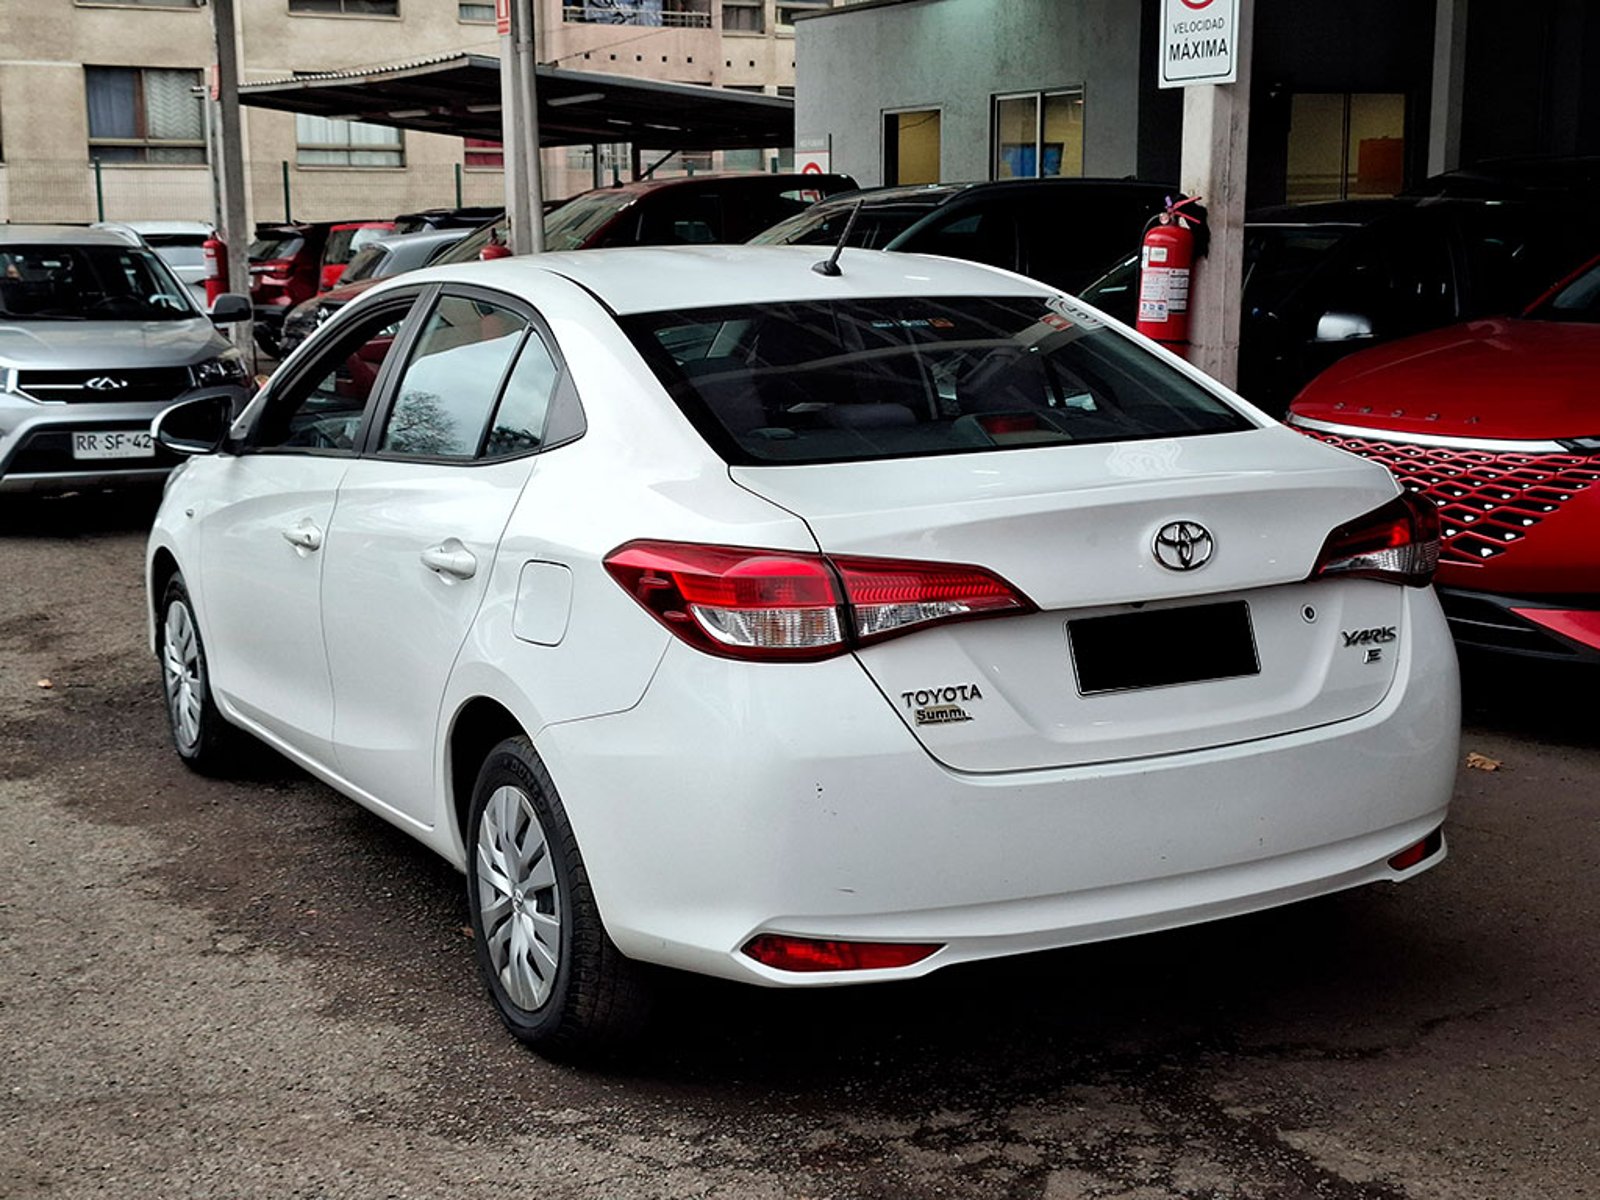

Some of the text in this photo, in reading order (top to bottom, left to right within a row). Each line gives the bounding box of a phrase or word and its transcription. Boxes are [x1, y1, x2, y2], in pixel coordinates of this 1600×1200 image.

[1173, 17, 1225, 34] VELOCIDAD
[1169, 37, 1228, 61] MÁXIMA
[1342, 626, 1396, 648] YARIS
[1363, 648, 1382, 664] E
[901, 683, 983, 708] TOYOTA
